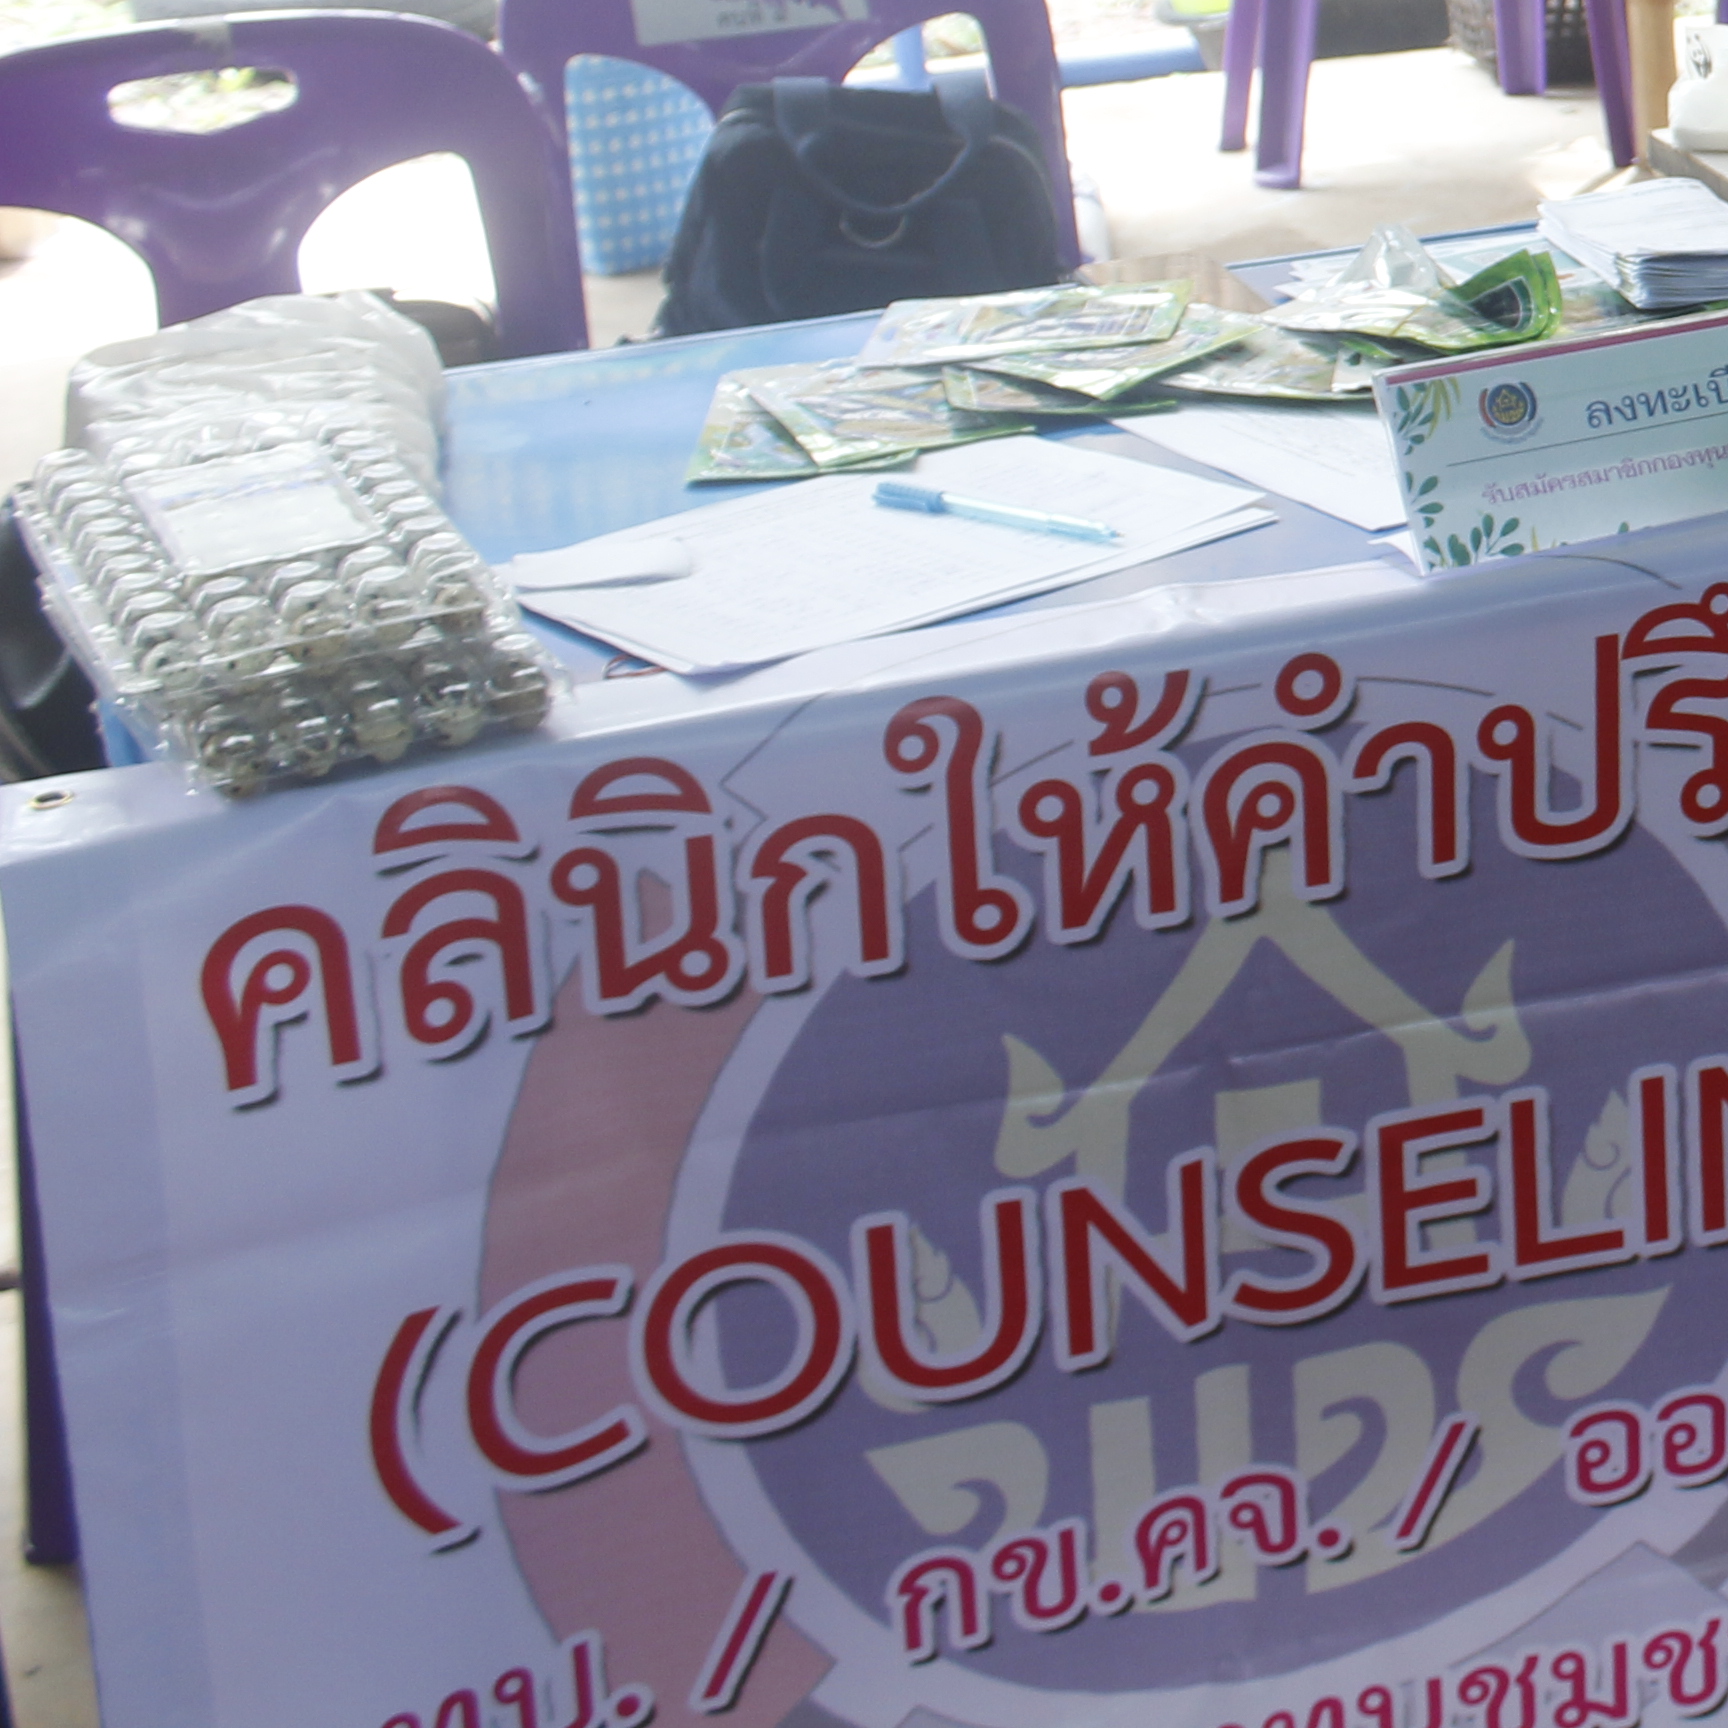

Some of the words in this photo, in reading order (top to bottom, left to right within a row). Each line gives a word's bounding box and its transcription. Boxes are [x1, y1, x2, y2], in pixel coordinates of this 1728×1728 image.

[703, 1570, 778, 1699] /
[897, 1467, 1341, 1652] กข.คจ.
[1398, 1420, 1468, 1540] /
